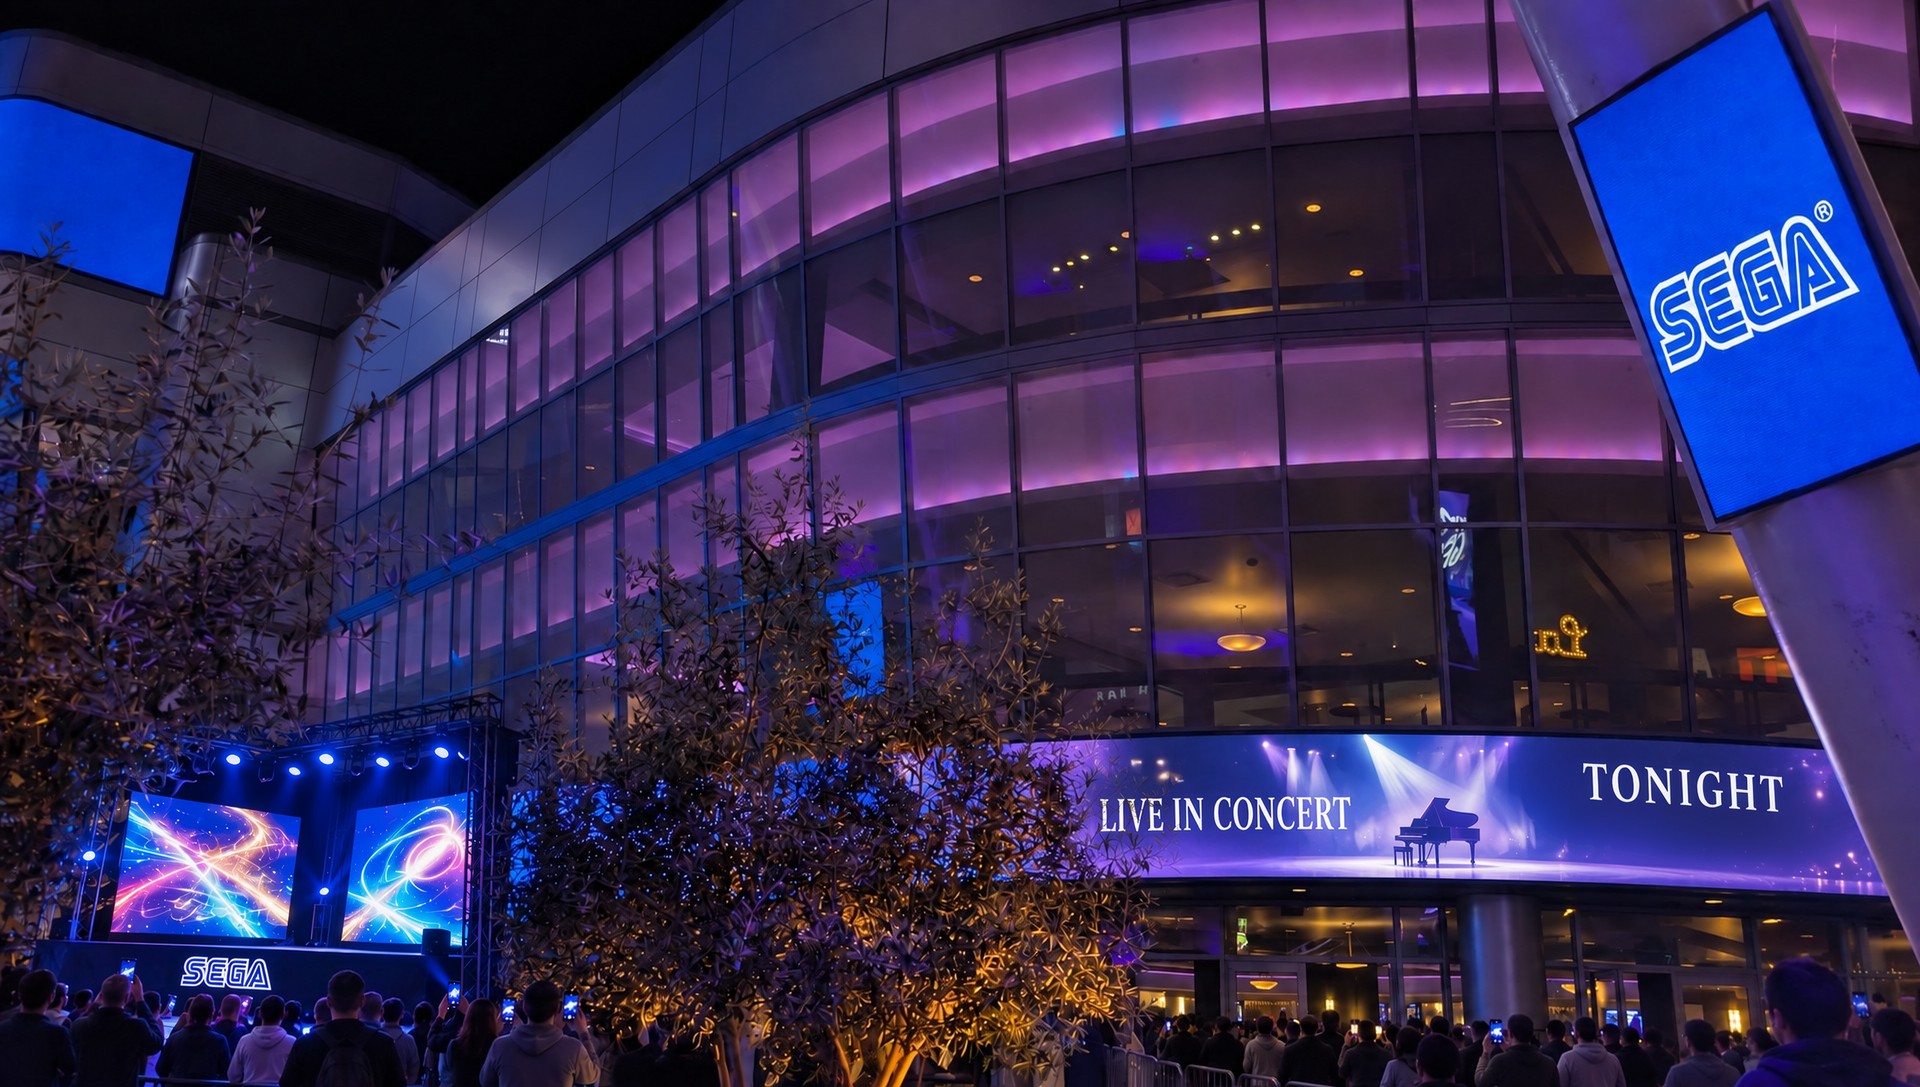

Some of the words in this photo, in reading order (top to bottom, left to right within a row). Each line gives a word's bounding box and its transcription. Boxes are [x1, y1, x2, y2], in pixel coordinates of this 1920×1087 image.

[1582, 762, 1783, 813] TONIGHT
[1100, 797, 1164, 832] LIVE
[1173, 797, 1203, 831] IN
[1213, 796, 1351, 831] CONCERT
[180, 956, 271, 990] SEGA
